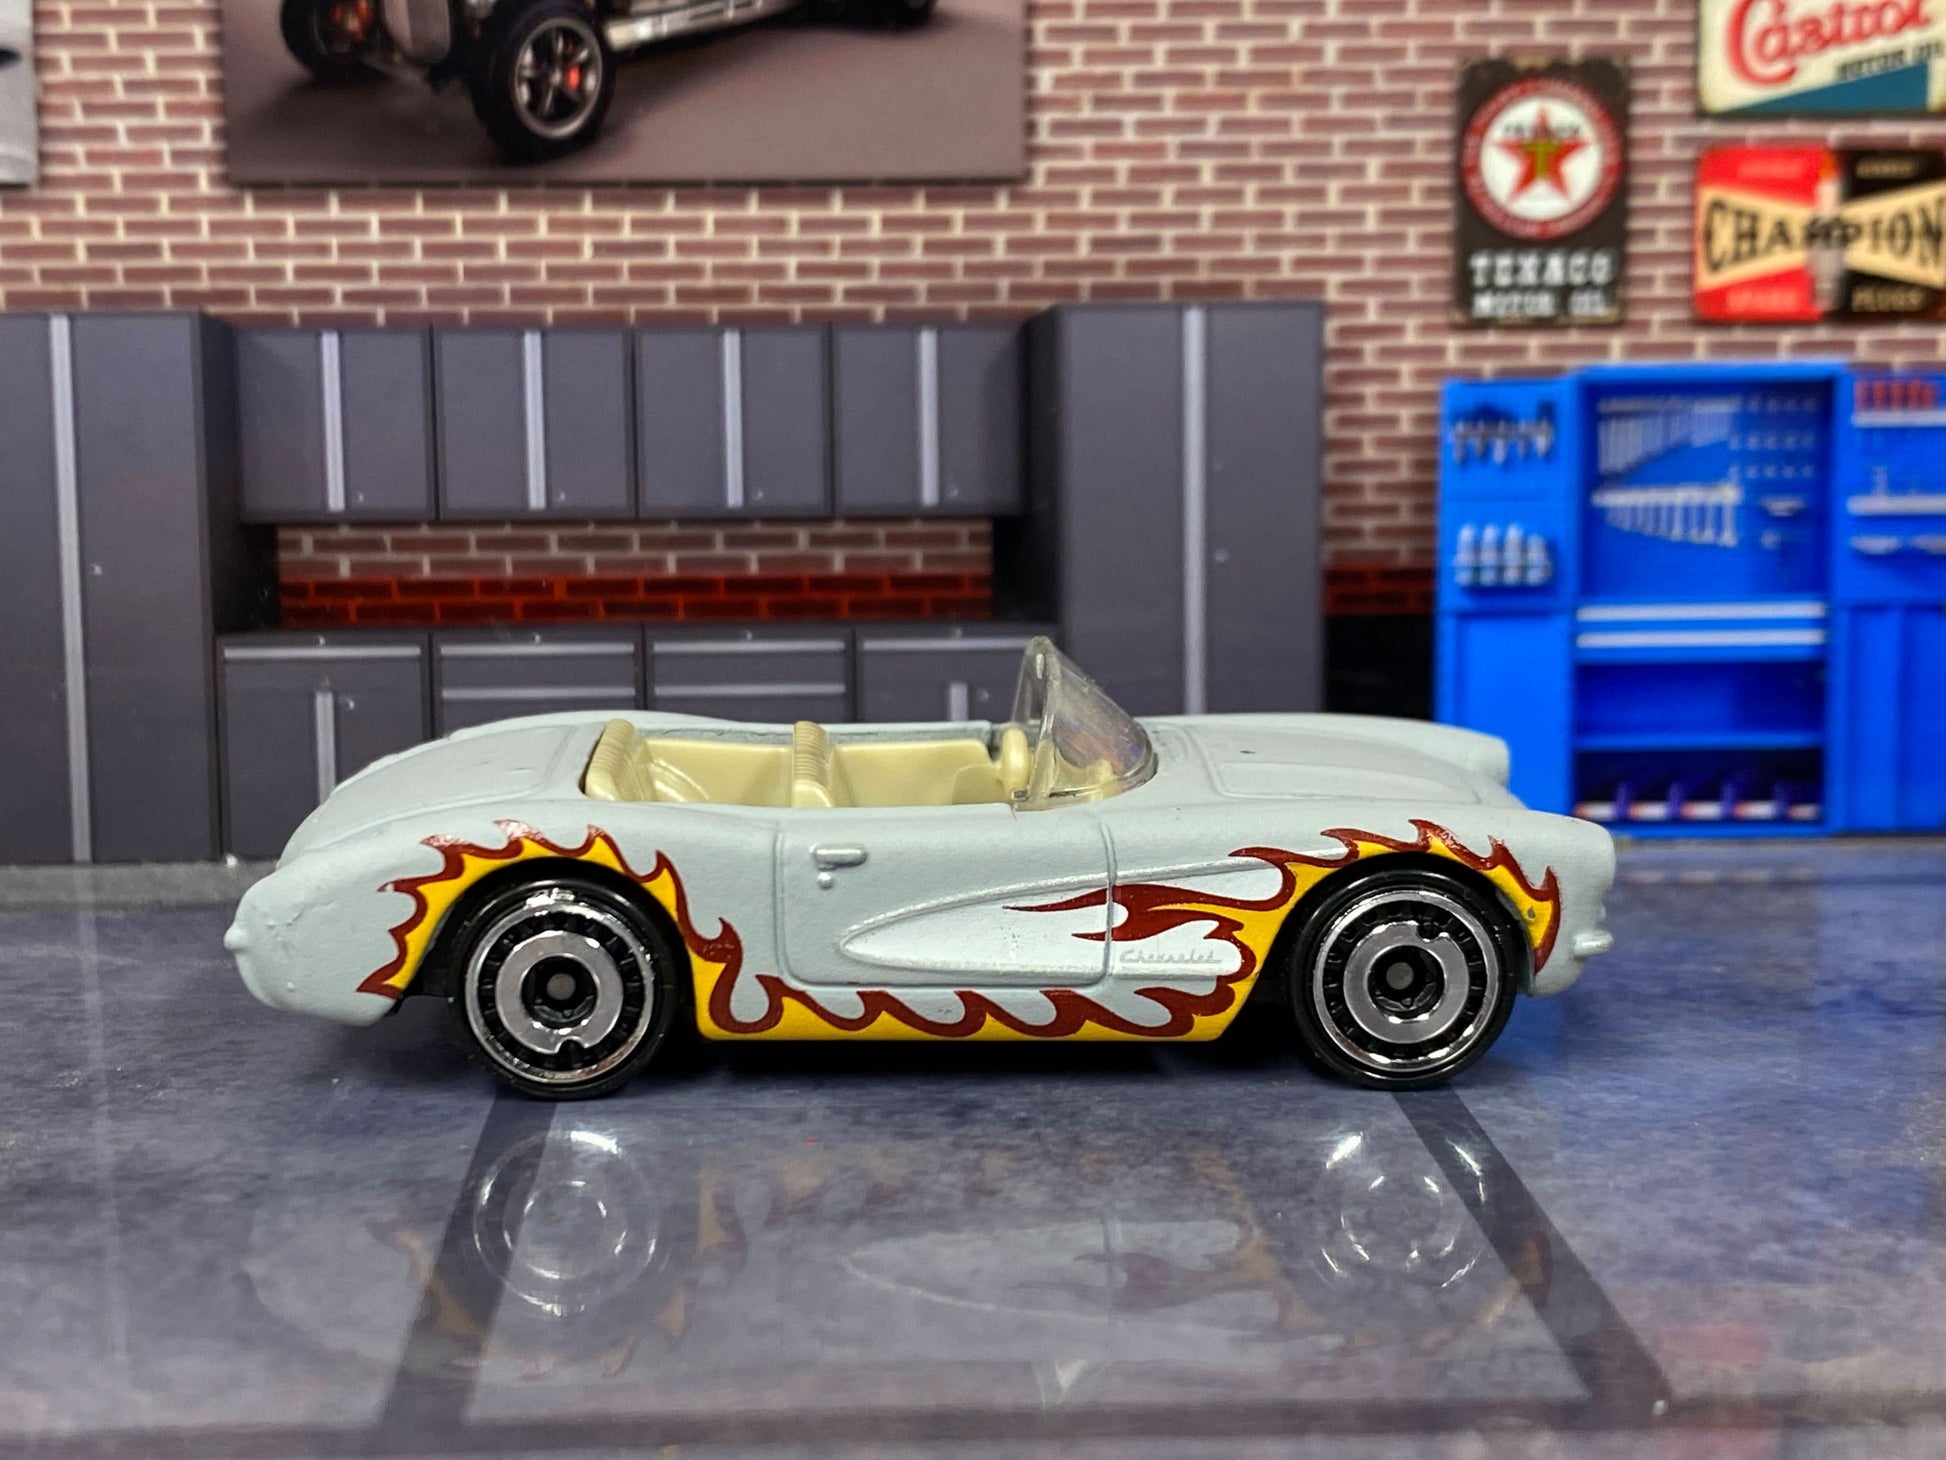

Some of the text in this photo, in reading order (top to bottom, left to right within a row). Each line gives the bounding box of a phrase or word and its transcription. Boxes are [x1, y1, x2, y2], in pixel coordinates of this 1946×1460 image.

[1726, 0, 1930, 87] Castrol
[1705, 195, 1946, 272] CHAMPION
[1470, 251, 1613, 287] TEXACO
[1472, 290, 1557, 318] MOTOR
[1118, 949, 1222, 965] Chevrolet
